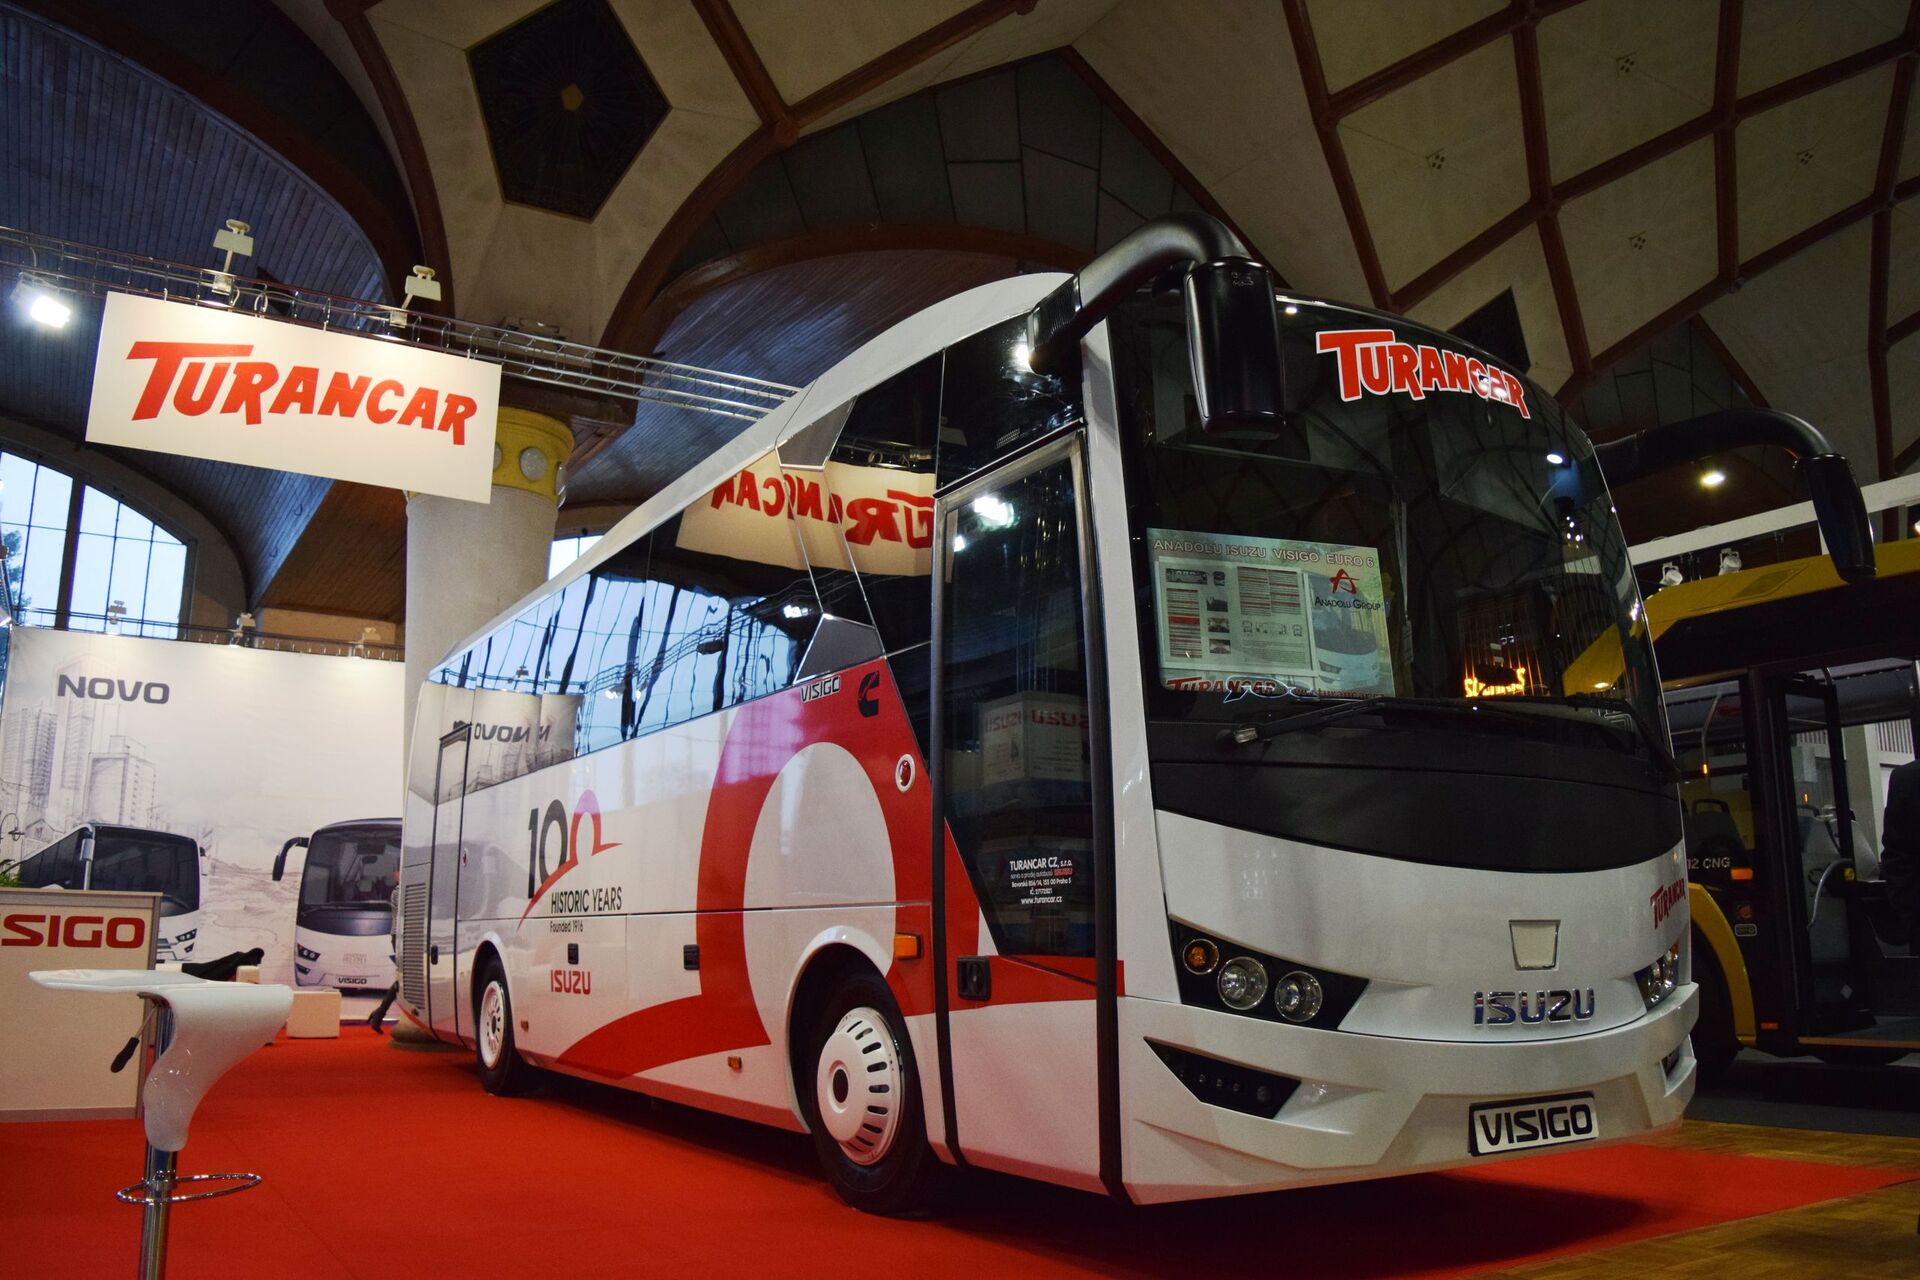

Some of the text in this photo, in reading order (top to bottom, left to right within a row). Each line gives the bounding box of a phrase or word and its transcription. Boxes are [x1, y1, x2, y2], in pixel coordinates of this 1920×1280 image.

[1315, 328, 1532, 419] TURANCAR
[126, 340, 478, 446] TURANCAR
[1153, 539, 1374, 568] ANADOLU ISUZU VISIGO EURO 6
[1314, 596, 1381, 611] ANADOLU GROUP
[57, 674, 170, 705] NOVO
[800, 676, 841, 702] VISIGO
[1009, 857, 1047, 871] TURANCAR
[1702, 856, 1731, 869] CNG
[550, 886, 622, 914] HISTORIC YEARS
[549, 919, 584, 933] Founded 1916
[338, 977, 368, 985] VISIGO
[551, 969, 591, 995] ISUZU
[1473, 987, 1596, 1027] ISUZU
[1479, 1103, 1594, 1147] VISIGO
